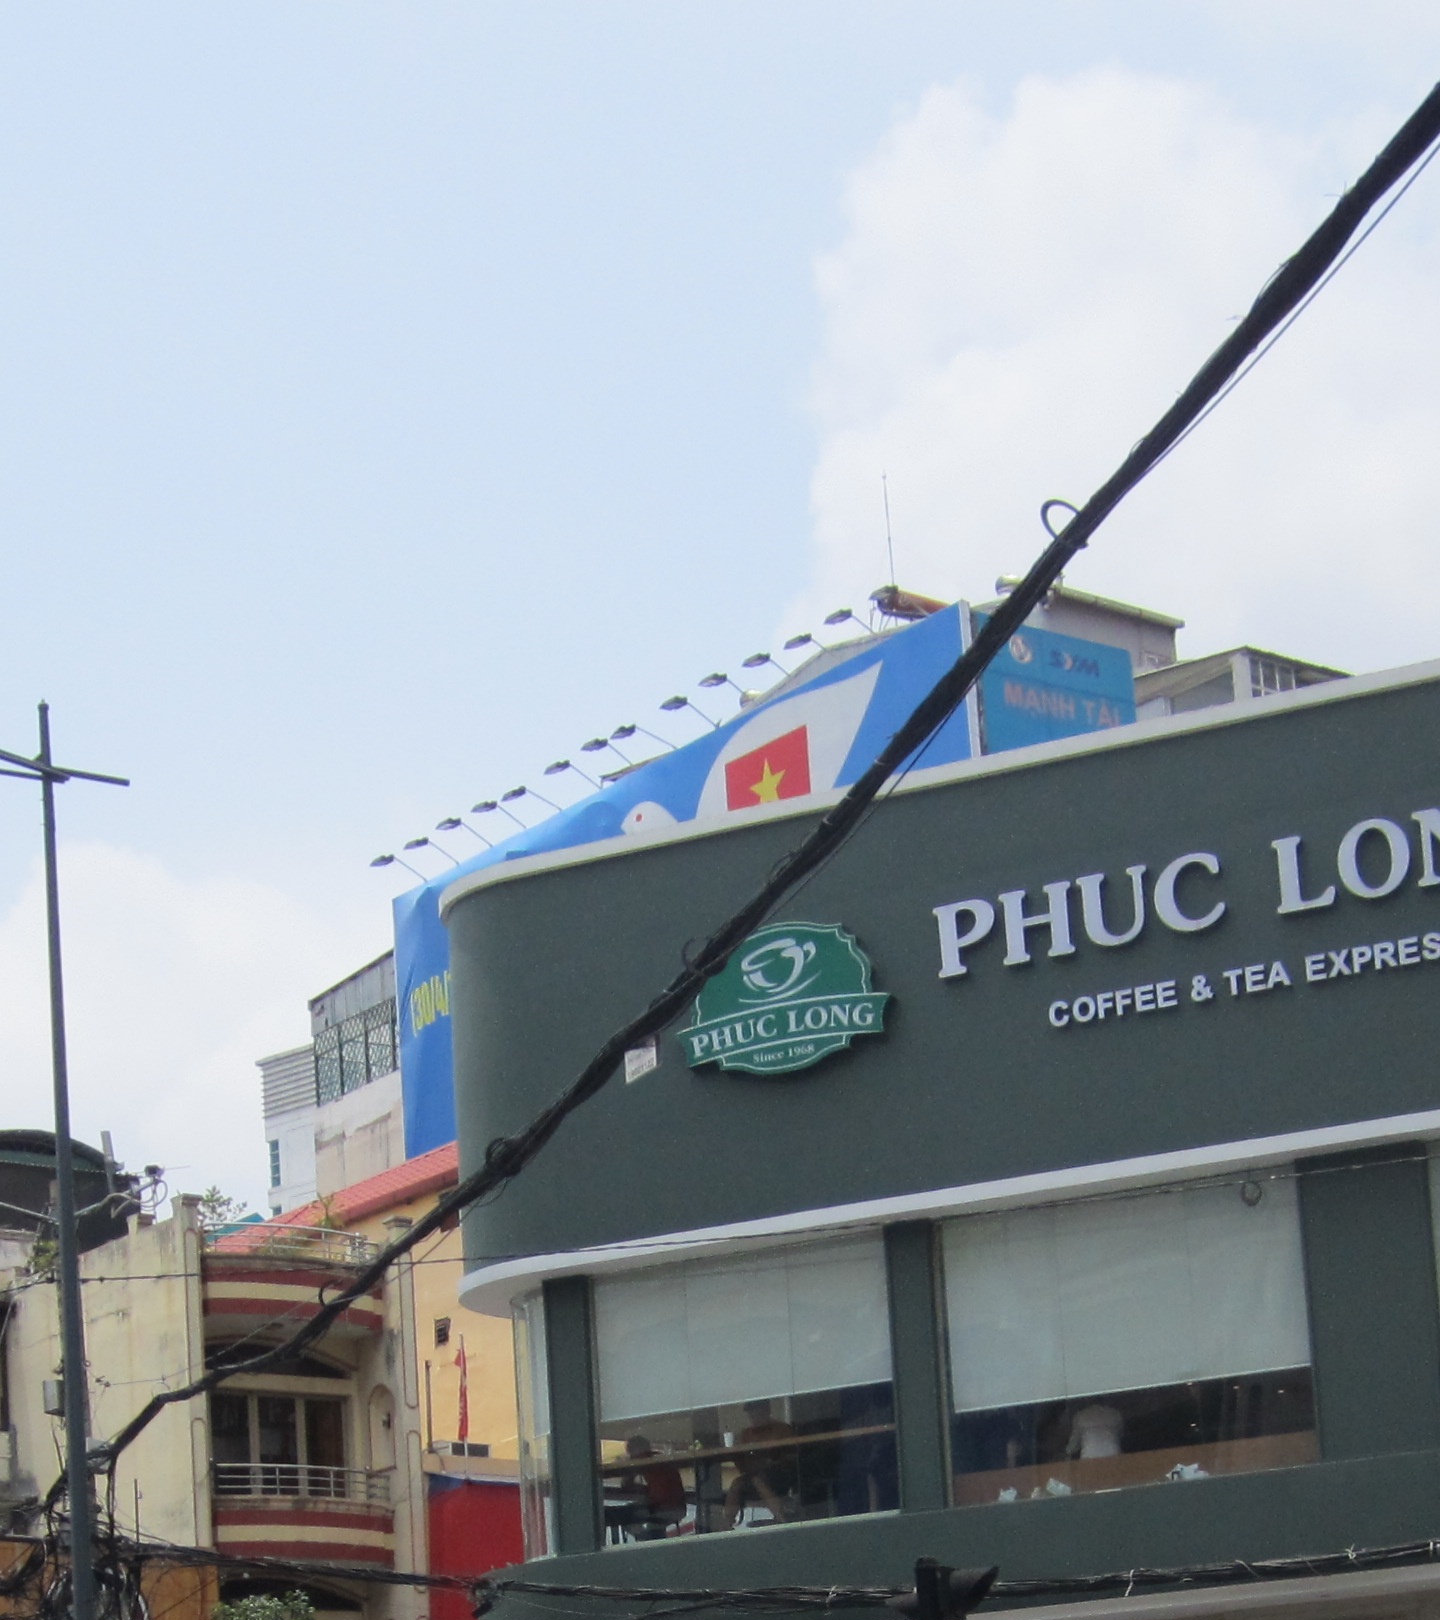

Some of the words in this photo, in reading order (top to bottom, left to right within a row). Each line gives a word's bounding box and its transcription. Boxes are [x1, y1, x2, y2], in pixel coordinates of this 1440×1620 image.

[932, 852, 1226, 979] PHUC
[1048, 980, 1178, 1028] COFFEE
[1190, 975, 1215, 1002] &
[1223, 961, 1292, 997] TEA
[689, 1014, 778, 1059] PHUC
[787, 1002, 875, 1033] LONG
[752, 1050, 785, 1064] Since
[788, 1043, 816, 1058] 1968
